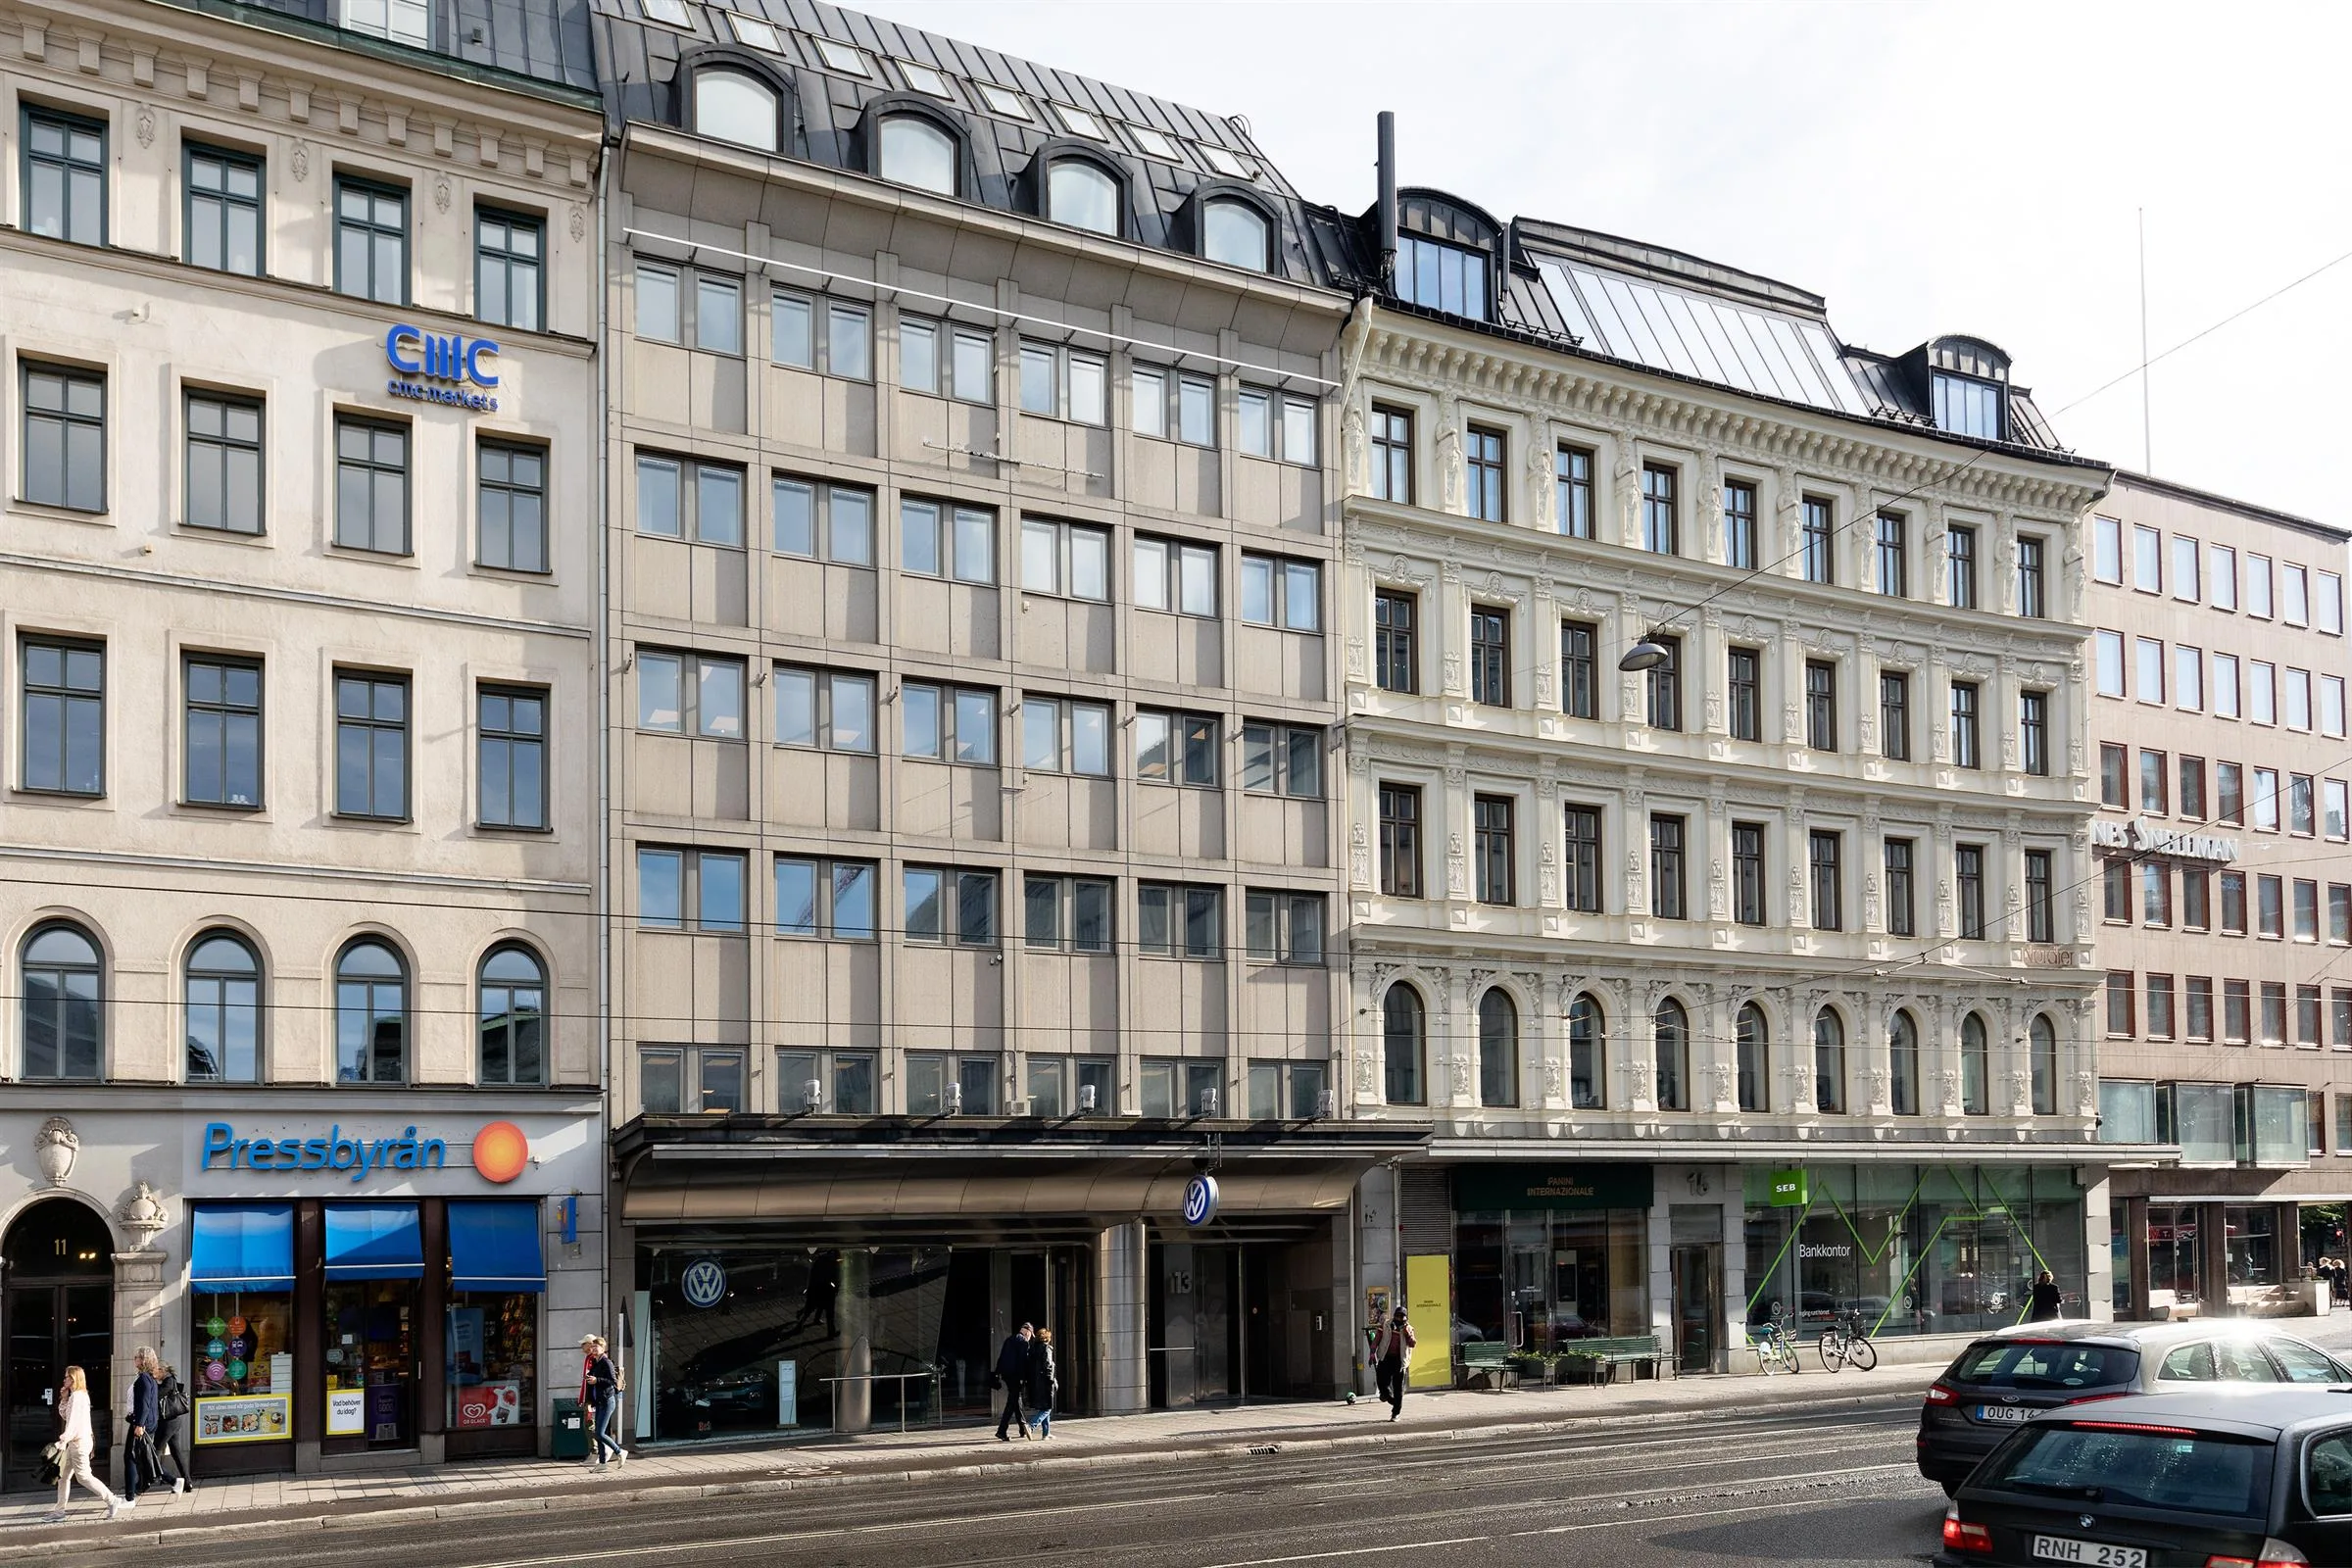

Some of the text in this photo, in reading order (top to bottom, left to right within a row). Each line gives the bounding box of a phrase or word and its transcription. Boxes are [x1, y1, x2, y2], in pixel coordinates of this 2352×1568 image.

[387, 378, 499, 413] cmc markets
[2133, 816, 2240, 861] SNELLMAN
[201, 1122, 447, 1182] Pressbyrån
[1547, 1176, 1574, 1186] PANINI
[1776, 1183, 1796, 1193] SEB
[1527, 1186, 1595, 1197] INTERNAZIONALE
[54, 1239, 67, 1255] 11
[1799, 1243, 1851, 1258] Bankkontor
[1987, 1406, 2047, 1420] OUG 14
[2037, 1538, 2143, 1568] RNH 252
